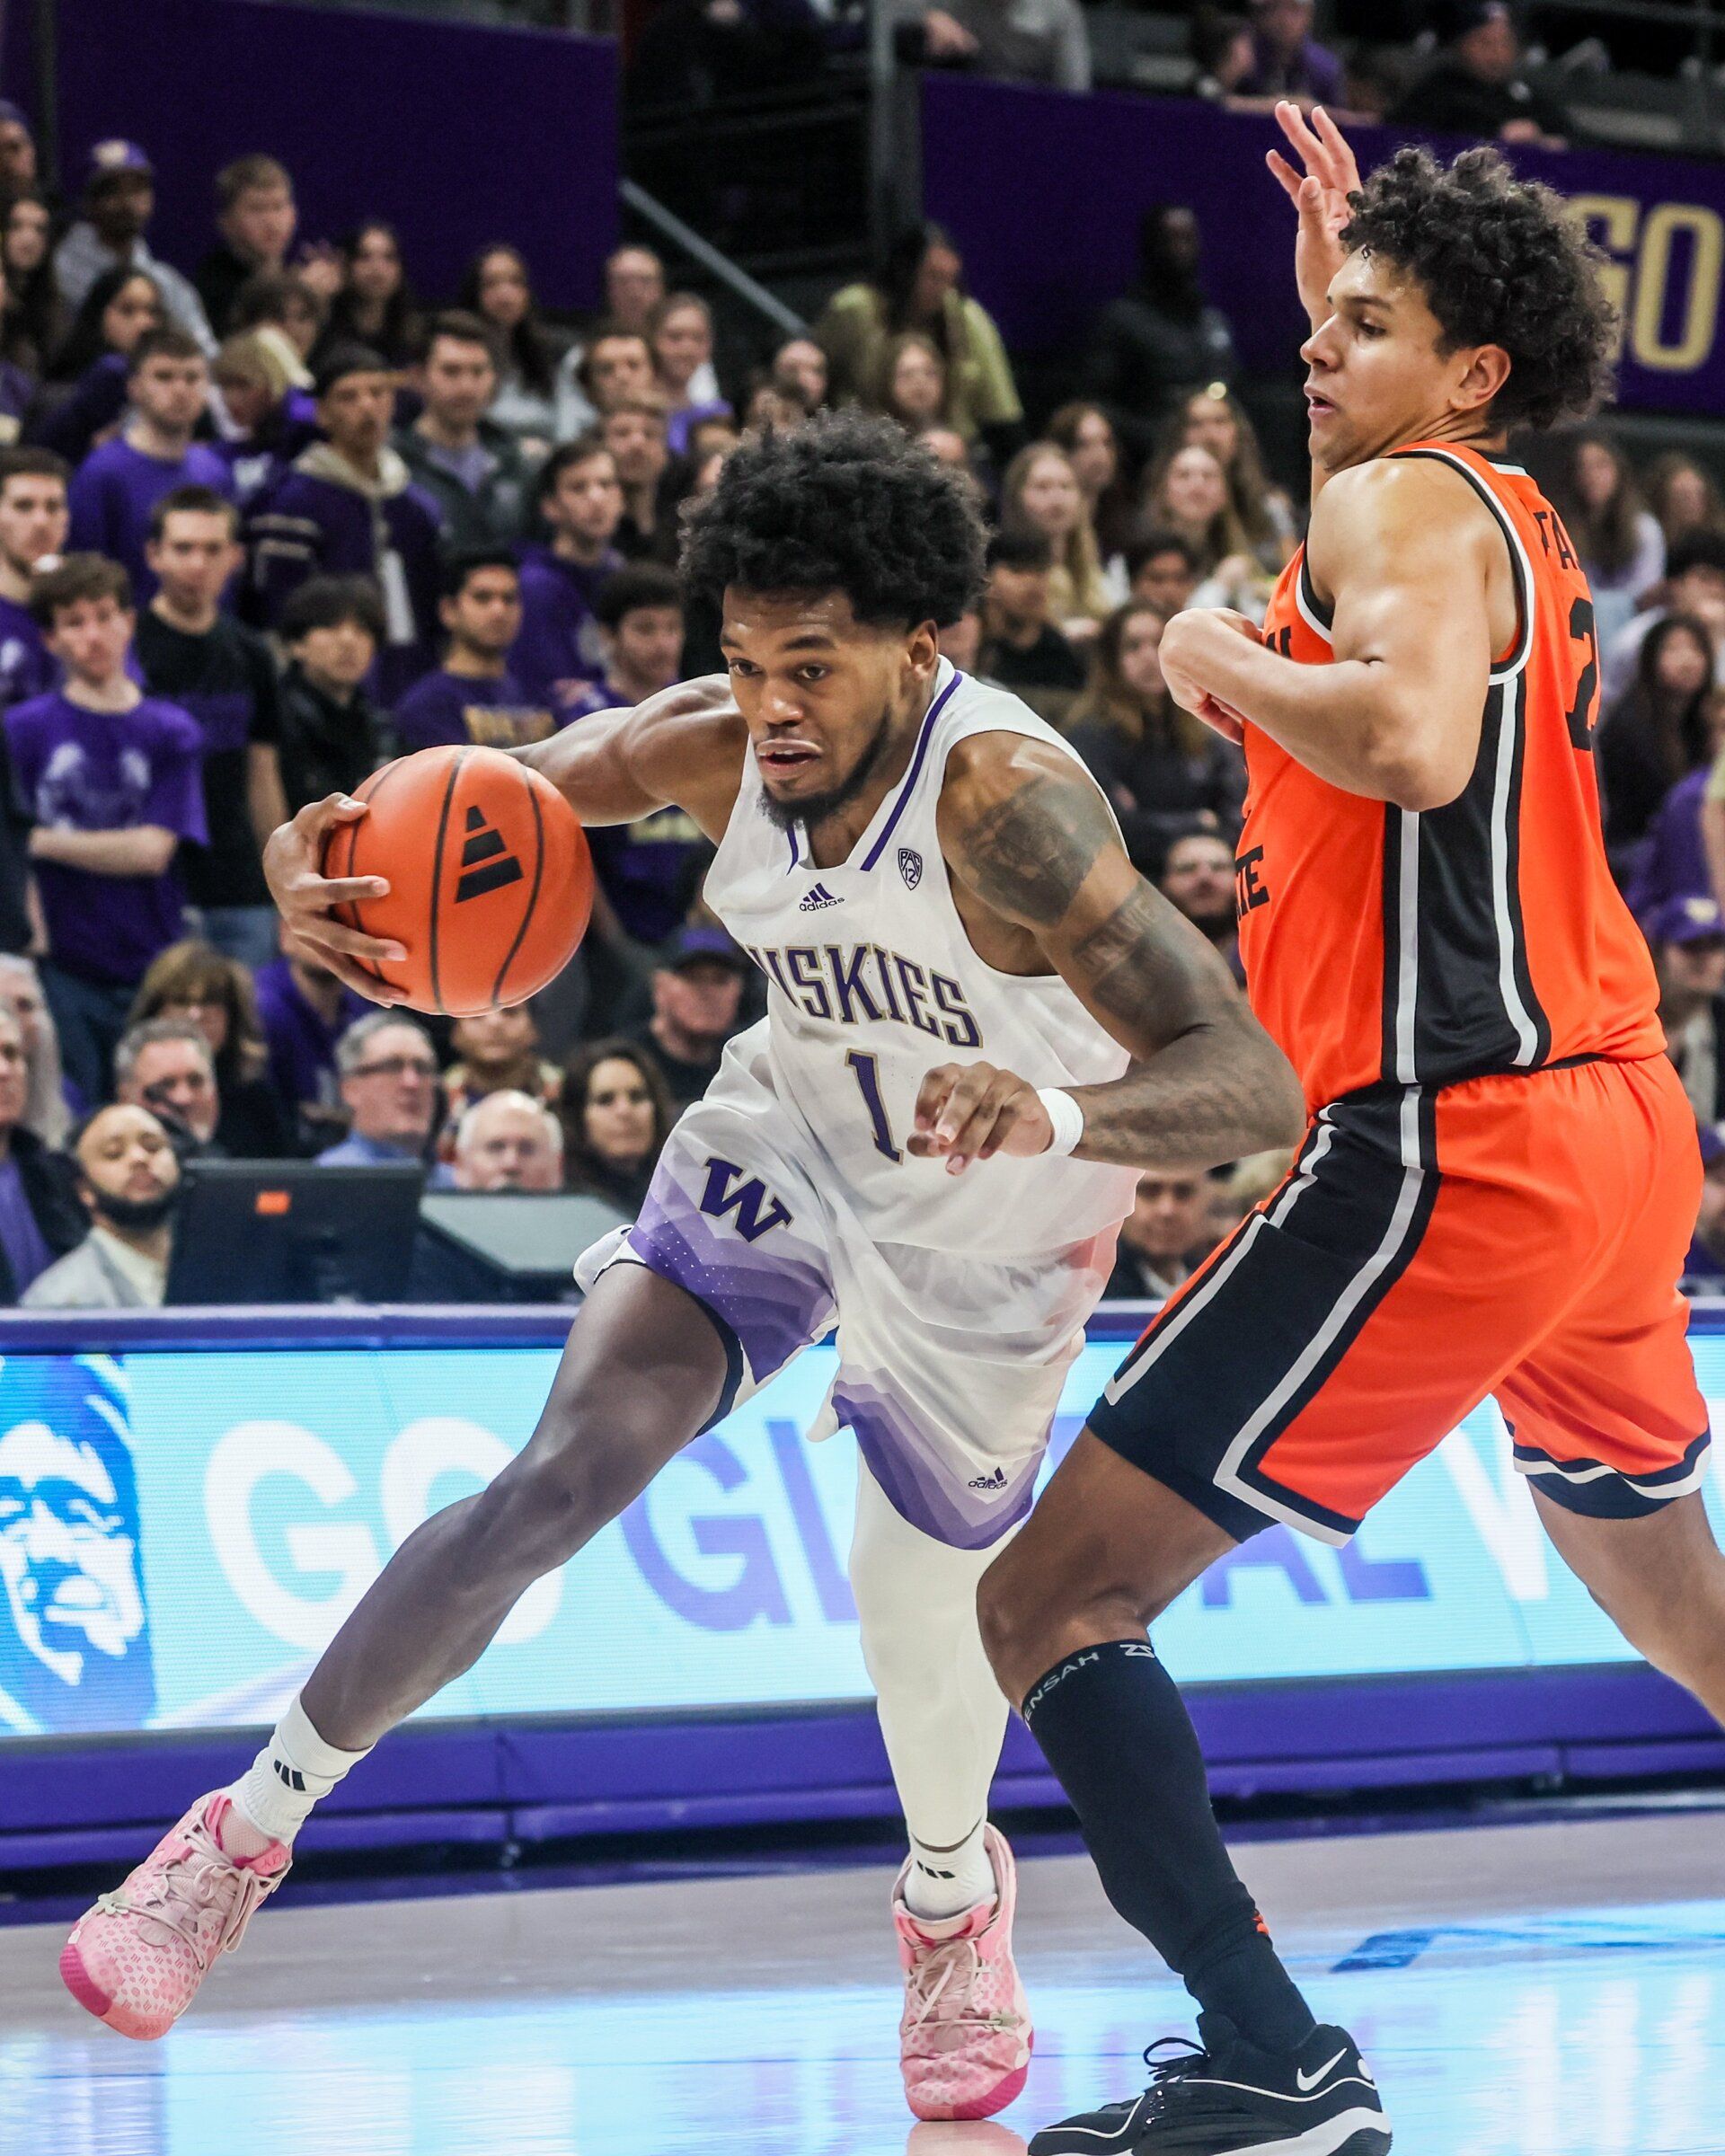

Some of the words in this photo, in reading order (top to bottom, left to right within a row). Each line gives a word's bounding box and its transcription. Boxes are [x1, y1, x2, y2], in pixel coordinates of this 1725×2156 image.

[900, 851, 920, 877] PAC
[905, 867, 916, 884] 12
[799, 897, 845, 912] adidas
[745, 941, 983, 1048] USKIES
[845, 1048, 904, 1165] 1
[697, 1155, 794, 1243] W
[968, 1479, 1008, 1489] adidas
